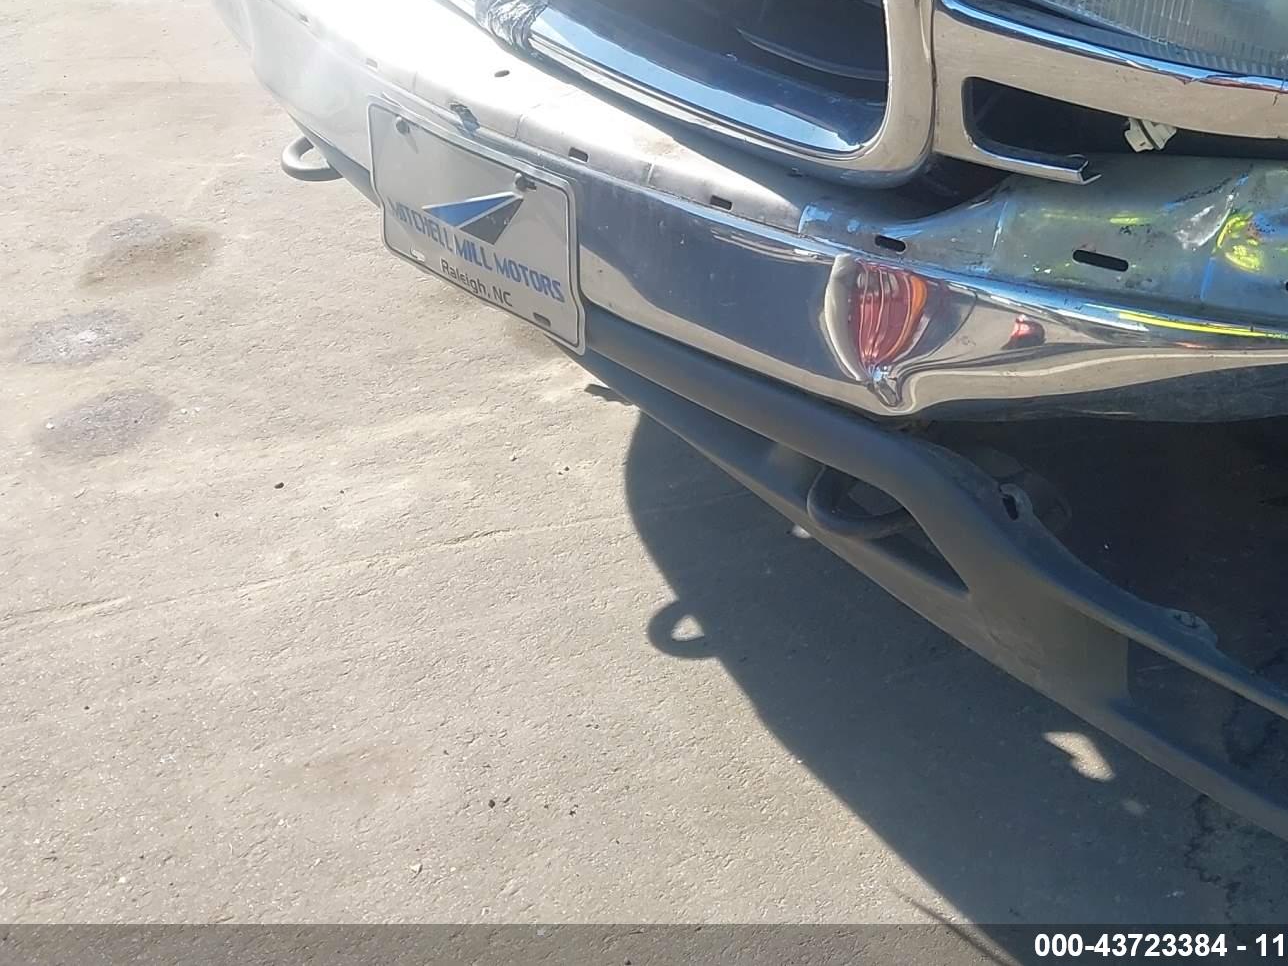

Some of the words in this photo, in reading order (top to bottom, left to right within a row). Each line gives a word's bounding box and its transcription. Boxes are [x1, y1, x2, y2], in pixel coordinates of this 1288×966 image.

[387, 195, 454, 253] MITCHELL
[453, 233, 494, 272] MILL
[494, 252, 566, 303] MOTORS
[491, 288, 513, 307] NC
